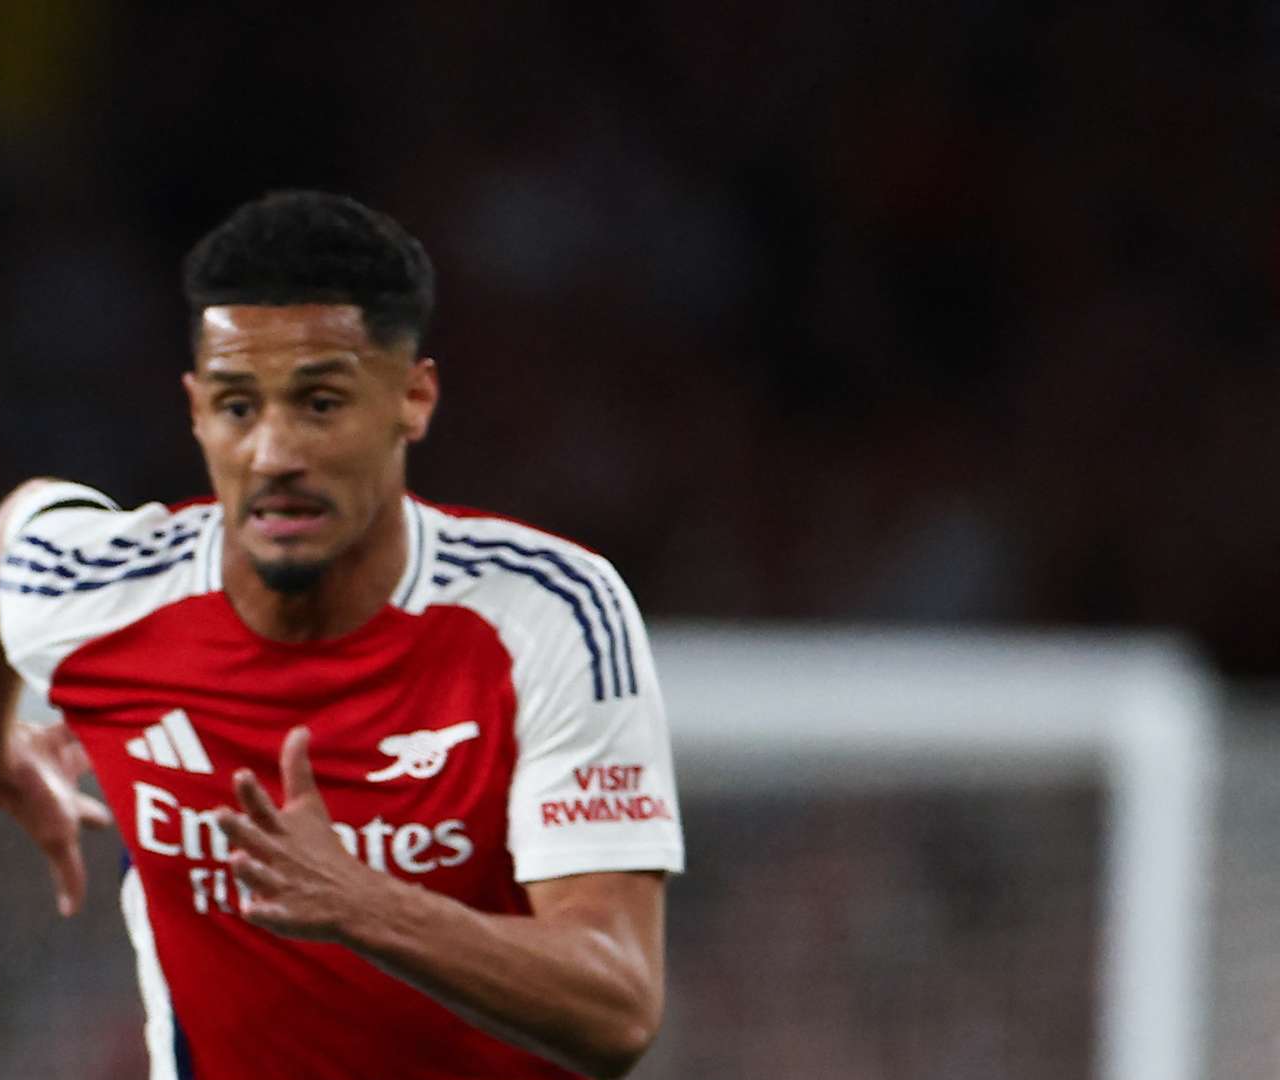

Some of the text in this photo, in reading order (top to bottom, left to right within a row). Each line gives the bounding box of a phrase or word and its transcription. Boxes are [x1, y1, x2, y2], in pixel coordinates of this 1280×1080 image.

[573, 764, 644, 791] VISIT
[134, 781, 474, 874] Emtes
[190, 868, 253, 914] FL
